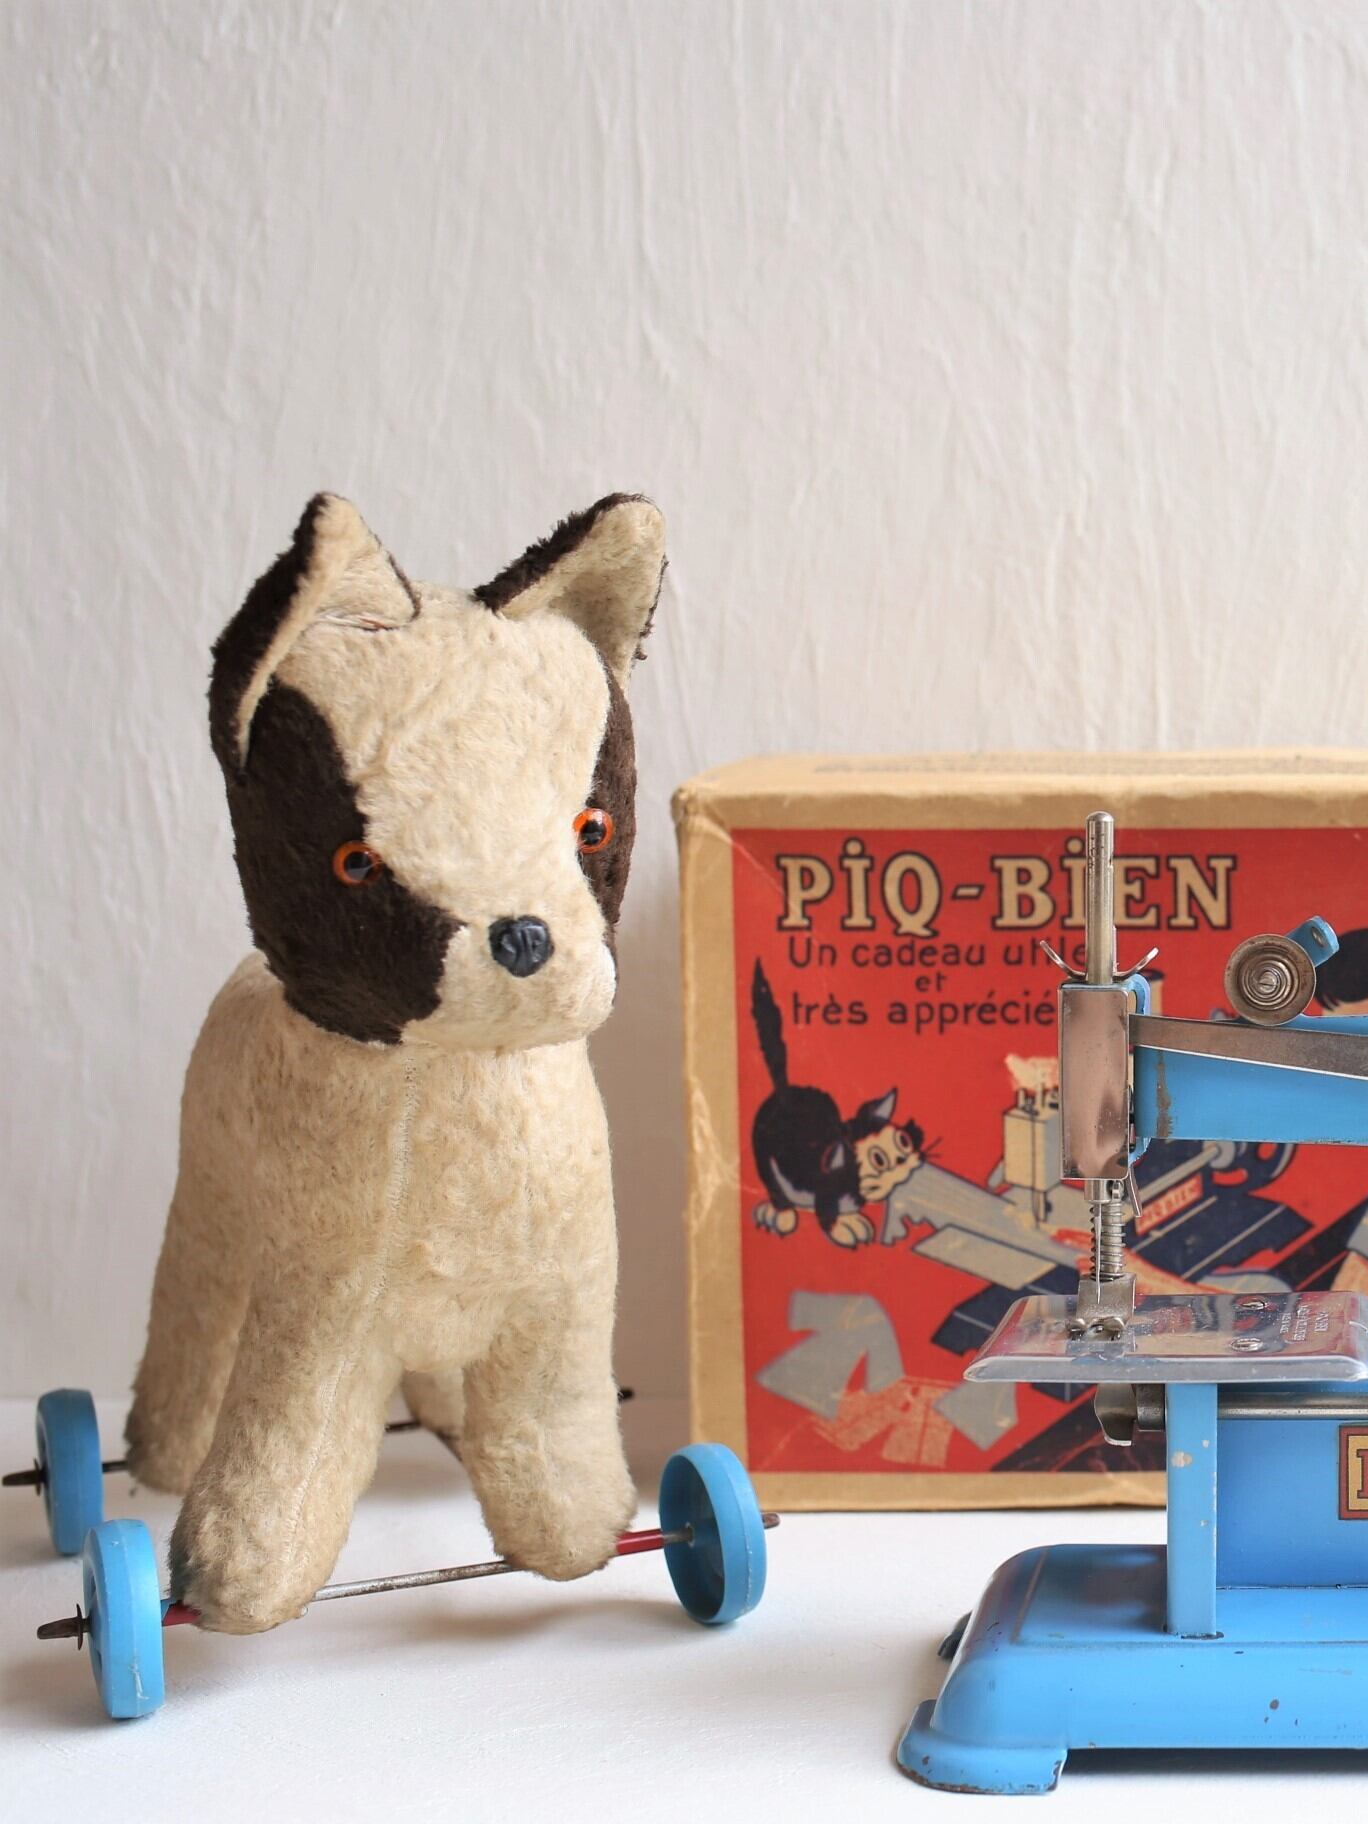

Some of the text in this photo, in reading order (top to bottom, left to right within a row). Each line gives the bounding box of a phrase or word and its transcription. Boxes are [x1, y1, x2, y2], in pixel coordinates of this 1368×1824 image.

[788, 936, 837, 968] Un
[851, 937, 986, 968] cadeau
[914, 971, 947, 992] et
[793, 989, 1056, 1035] très apprécié
